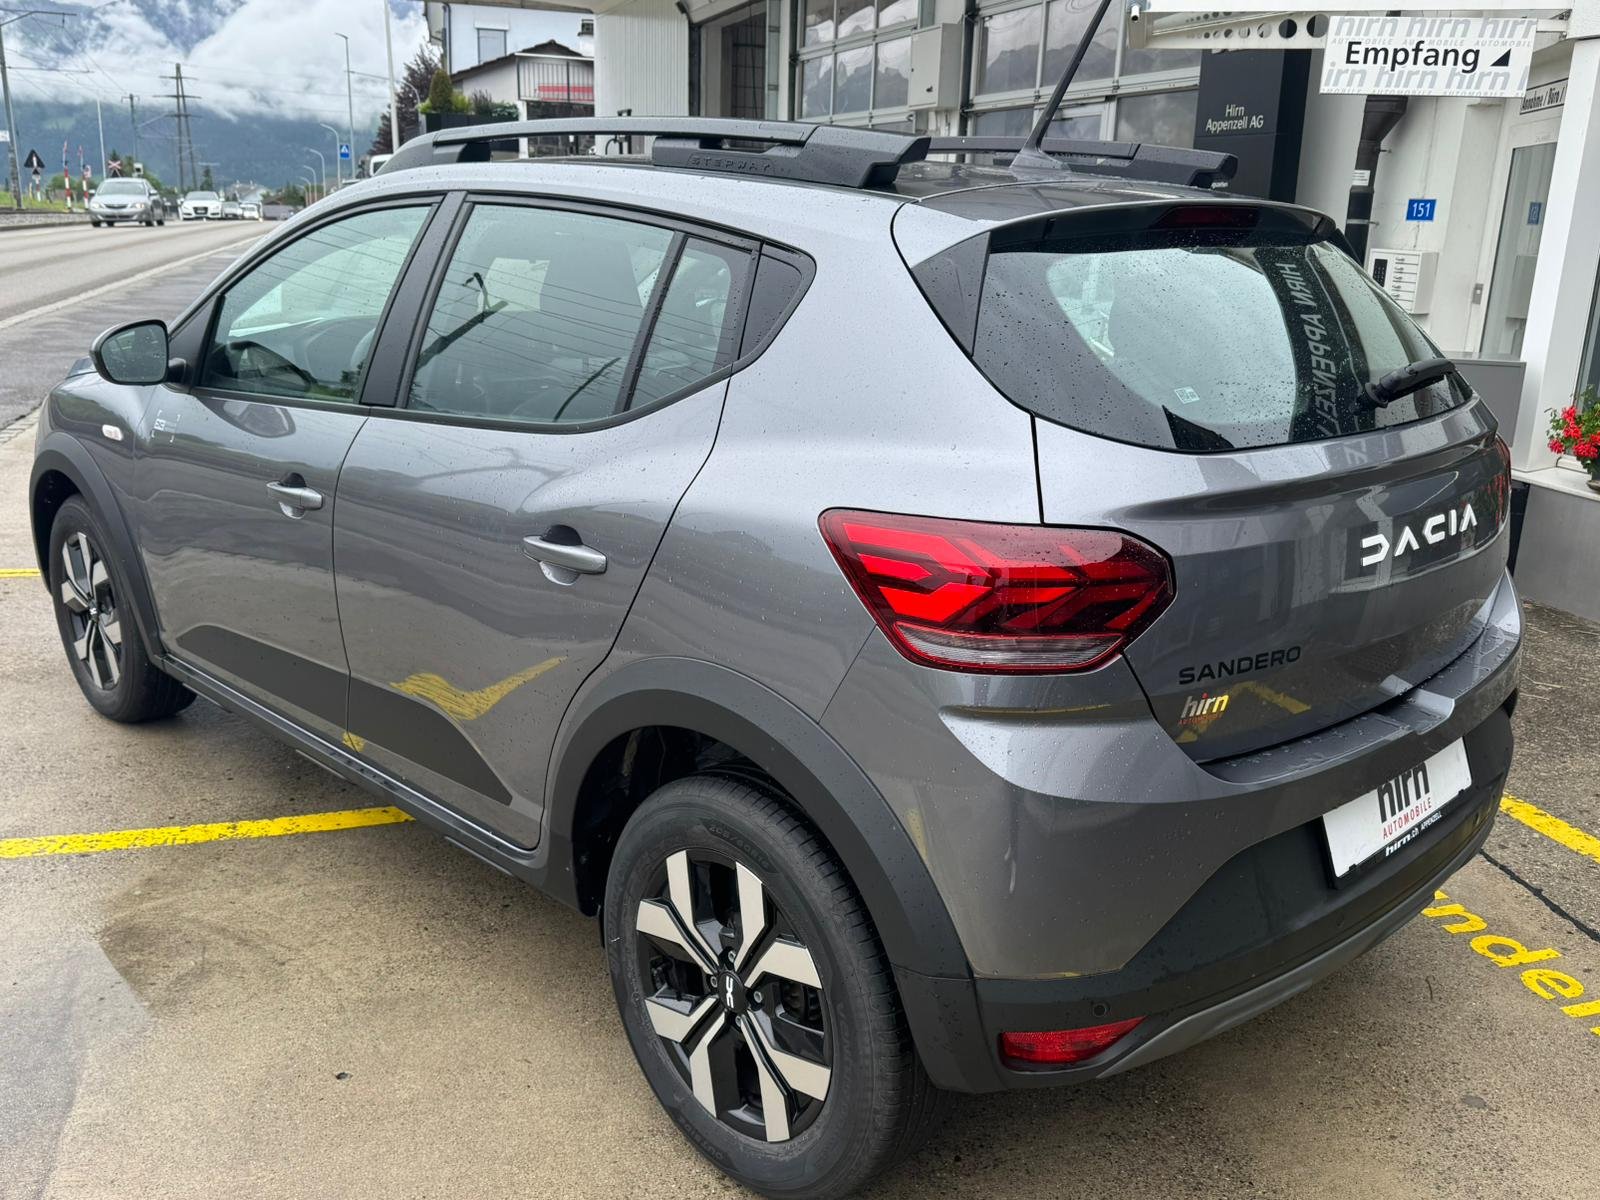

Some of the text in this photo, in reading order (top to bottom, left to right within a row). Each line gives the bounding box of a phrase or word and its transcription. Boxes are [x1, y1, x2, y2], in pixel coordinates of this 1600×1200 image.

[1345, 40, 1481, 74] Empfang
[1205, 115, 1264, 134] Appenzell AG
[1225, 103, 1245, 117] Hirn
[1412, 202, 1431, 217] 151
[1360, 503, 1478, 567] DACIA
[1178, 646, 1302, 685] SANDERO
[1180, 692, 1230, 719] hirn
[1382, 797, 1432, 840] AUTOMOBILE
